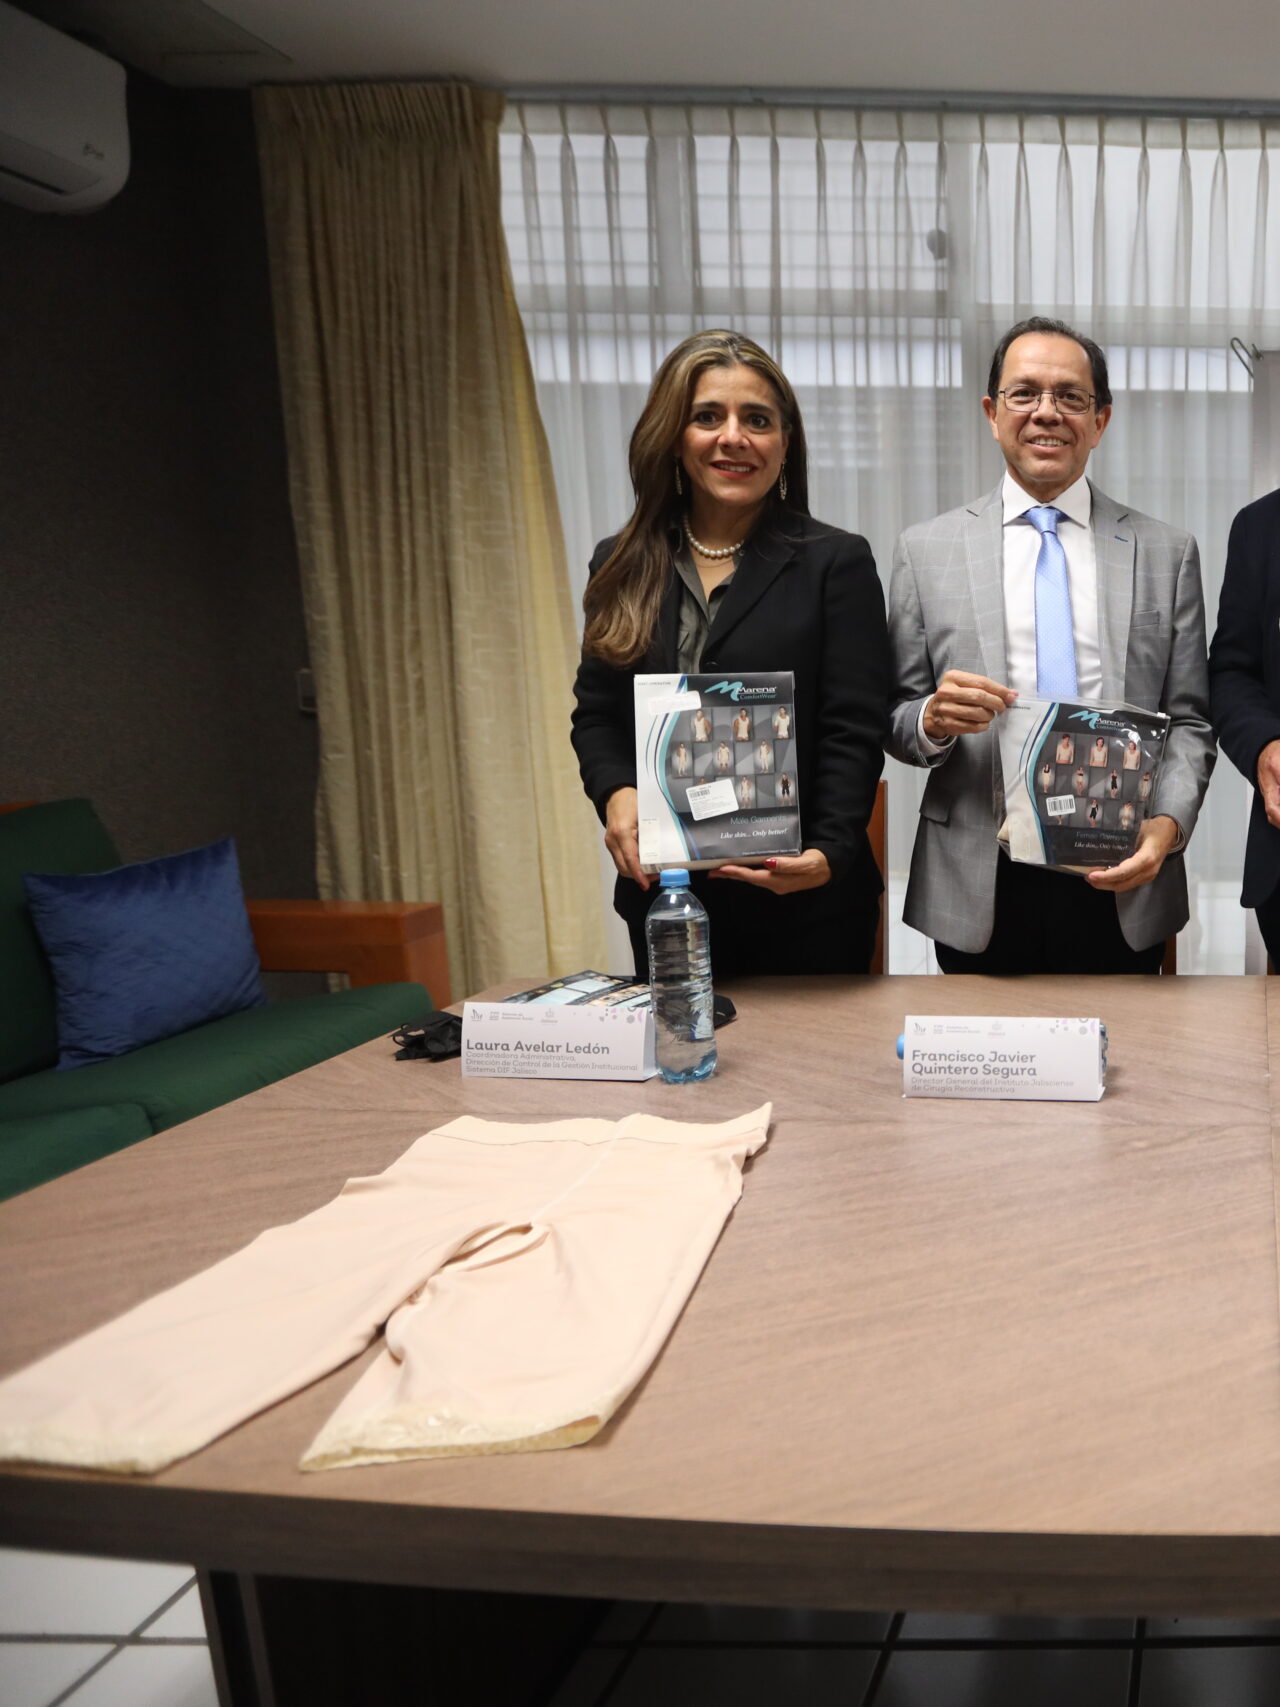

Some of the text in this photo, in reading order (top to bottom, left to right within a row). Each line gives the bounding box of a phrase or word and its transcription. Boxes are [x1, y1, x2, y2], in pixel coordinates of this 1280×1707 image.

[752, 829, 767, 838] Only
[466, 1039, 610, 1055] Laura Avelar Ledón
[466, 1051, 519, 1059] Coordinadora
[912, 1050, 1037, 1063] Francisco Javier
[466, 1058, 500, 1066] Dirección
[591, 1063, 638, 1071] Institucional
[511, 1067, 538, 1075] Jalisco
[912, 1062, 1037, 1079] Quintero Segura
[912, 1077, 944, 1085] Director
